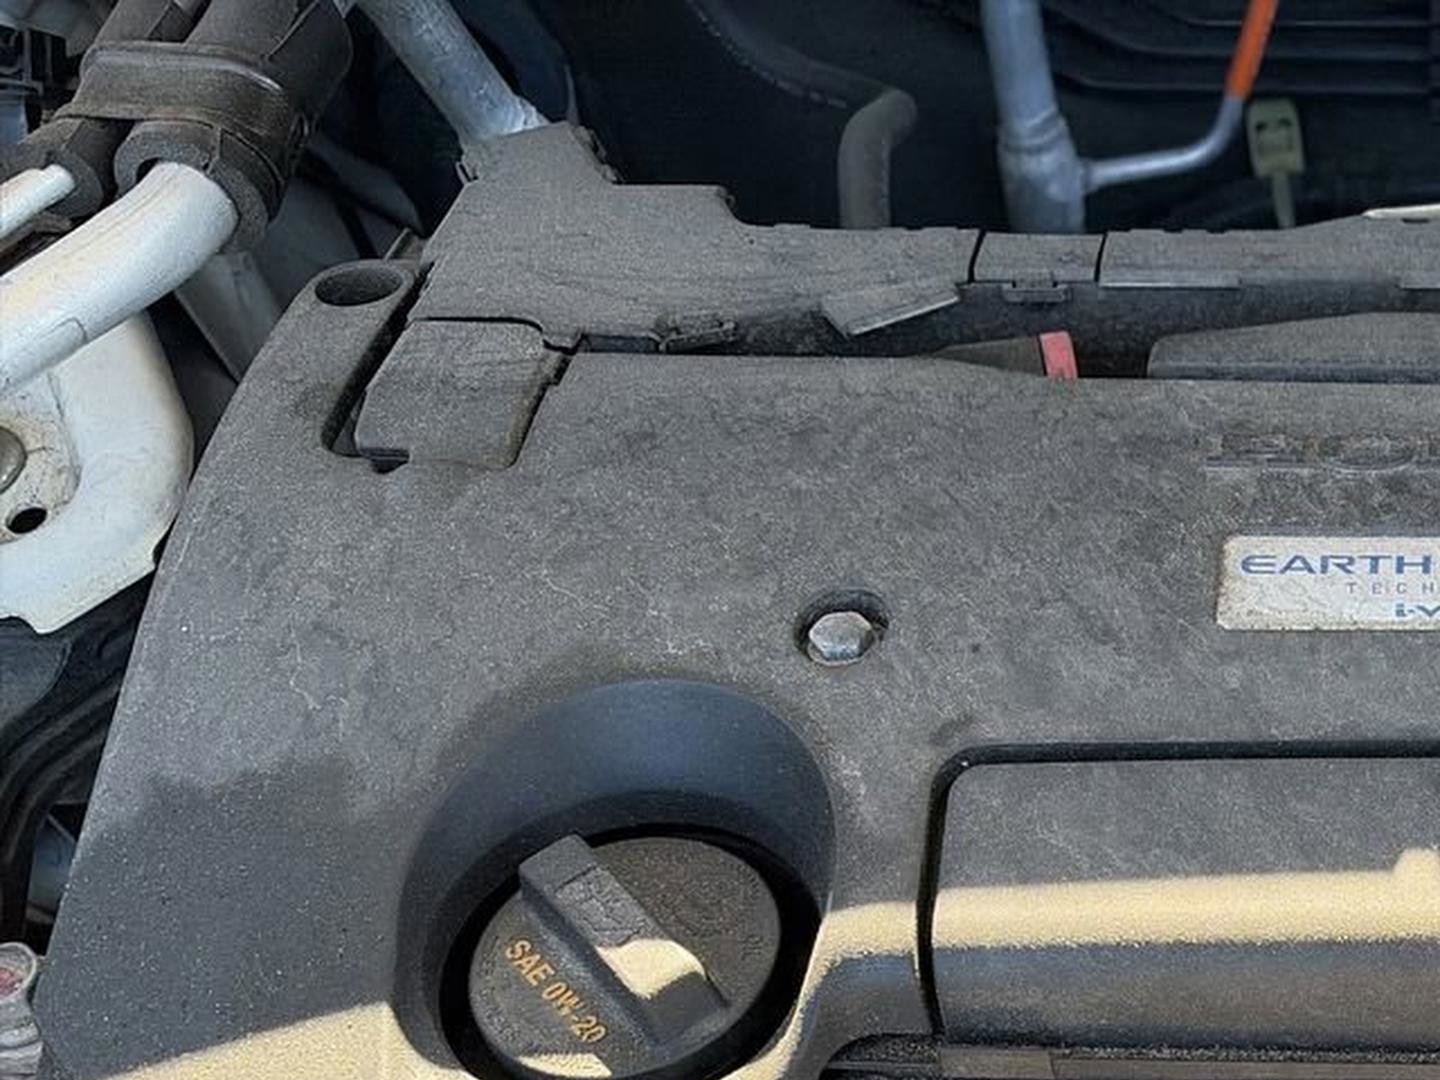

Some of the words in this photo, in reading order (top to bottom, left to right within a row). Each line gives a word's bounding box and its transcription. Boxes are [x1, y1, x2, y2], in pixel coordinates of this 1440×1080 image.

[1240, 555, 1433, 575] EARTH
[505, 939, 555, 987] SAE
[542, 981, 607, 1043] 0W-20
